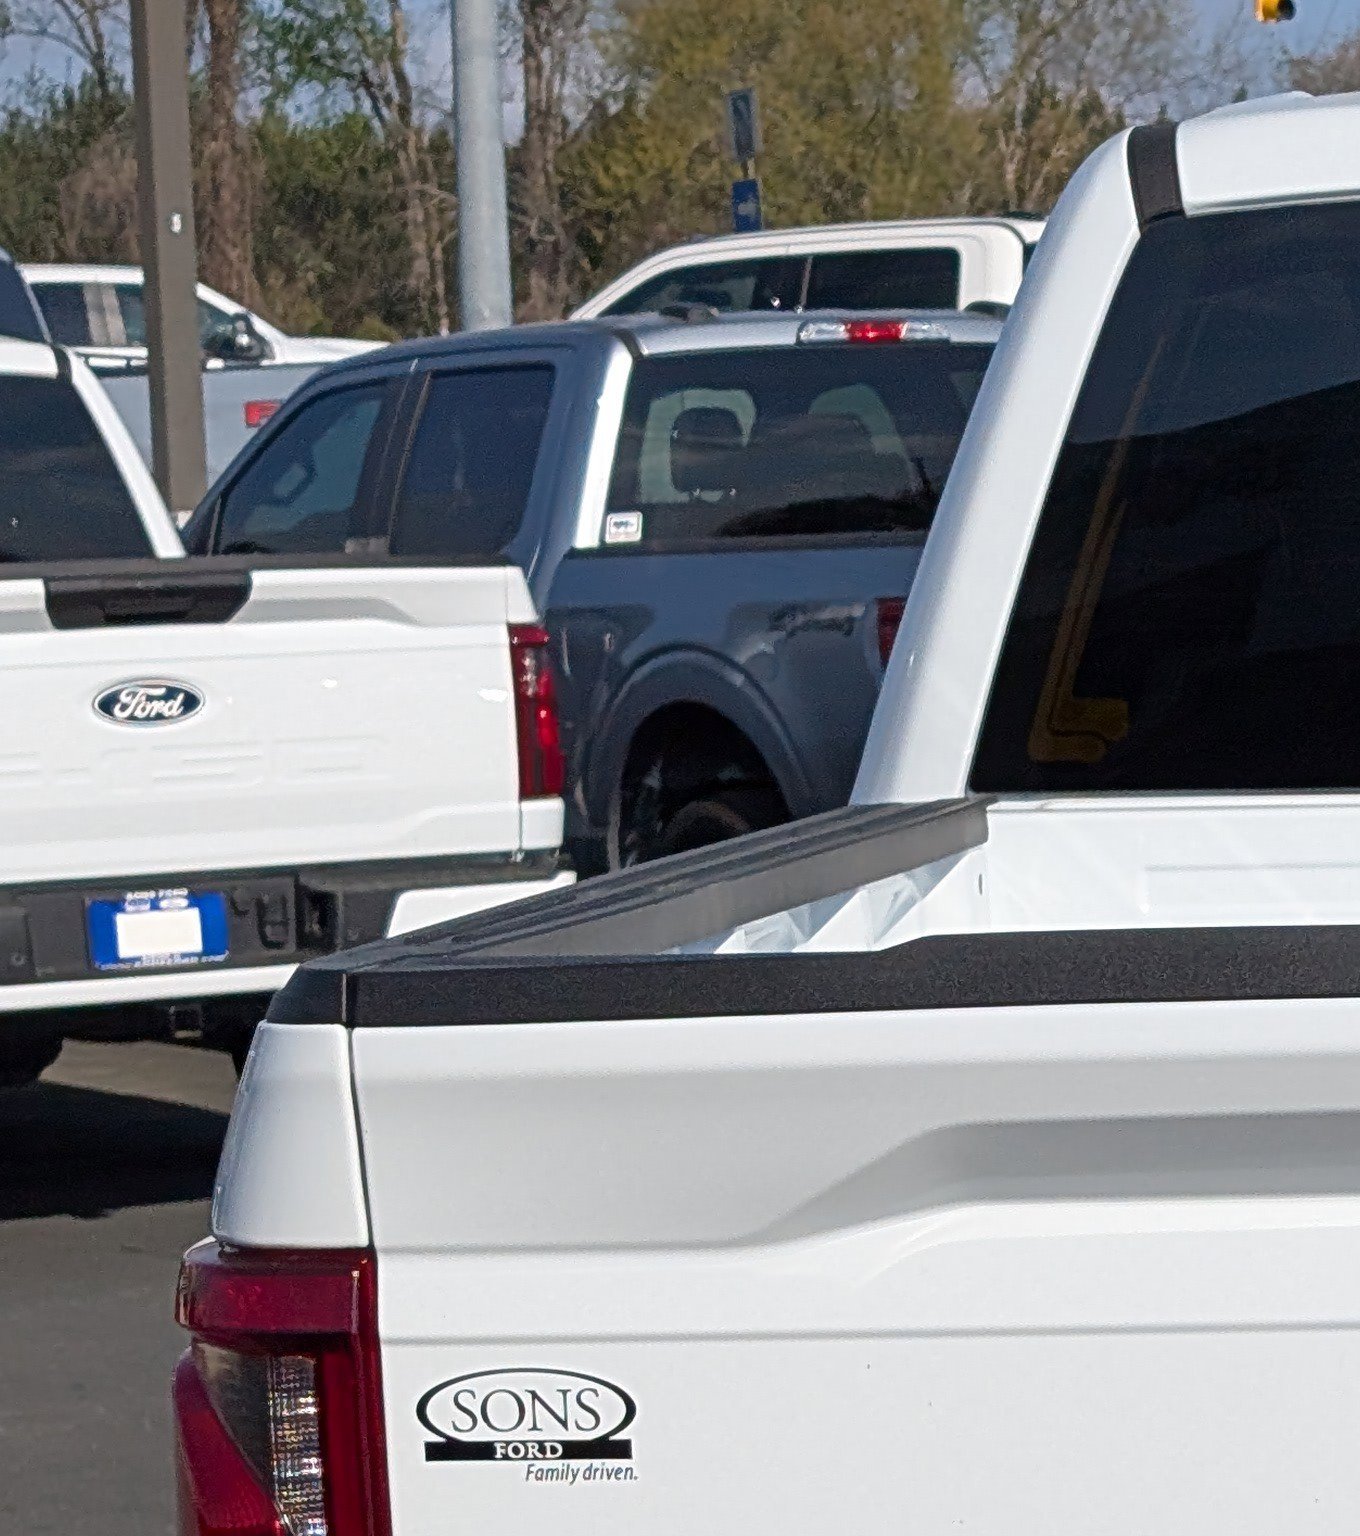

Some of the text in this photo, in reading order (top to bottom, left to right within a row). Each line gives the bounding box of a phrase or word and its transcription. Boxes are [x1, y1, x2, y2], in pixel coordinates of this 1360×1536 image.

[112, 686, 184, 719] Ford
[450, 1387, 601, 1433] SONS
[494, 1441, 563, 1459] FORD
[525, 1462, 638, 1486] Family driven.
